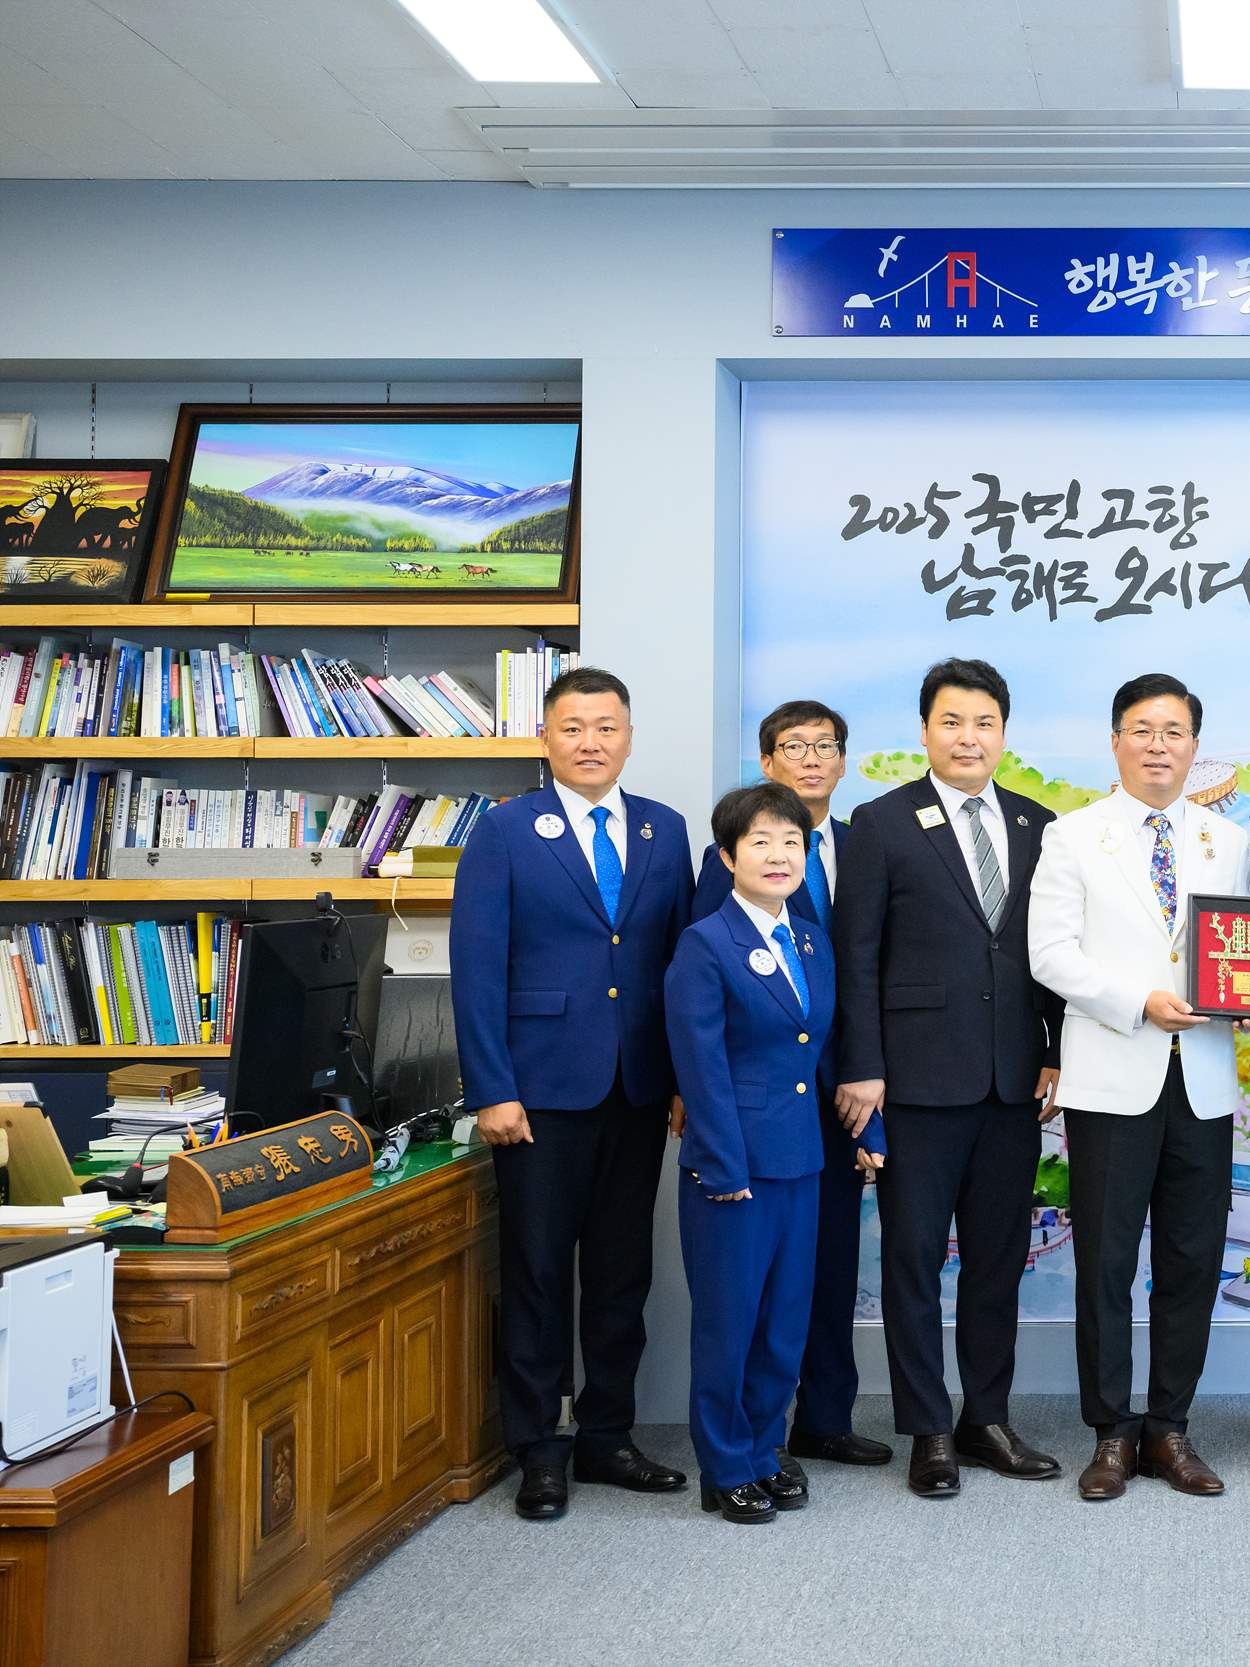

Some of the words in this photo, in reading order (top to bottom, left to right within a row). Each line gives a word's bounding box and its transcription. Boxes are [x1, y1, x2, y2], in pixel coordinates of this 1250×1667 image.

[1064, 252, 1219, 314] 행복한
[843, 314, 1039, 328] NAMHAE
[841, 482, 962, 541] 2025
[921, 543, 1099, 622] 남해로
